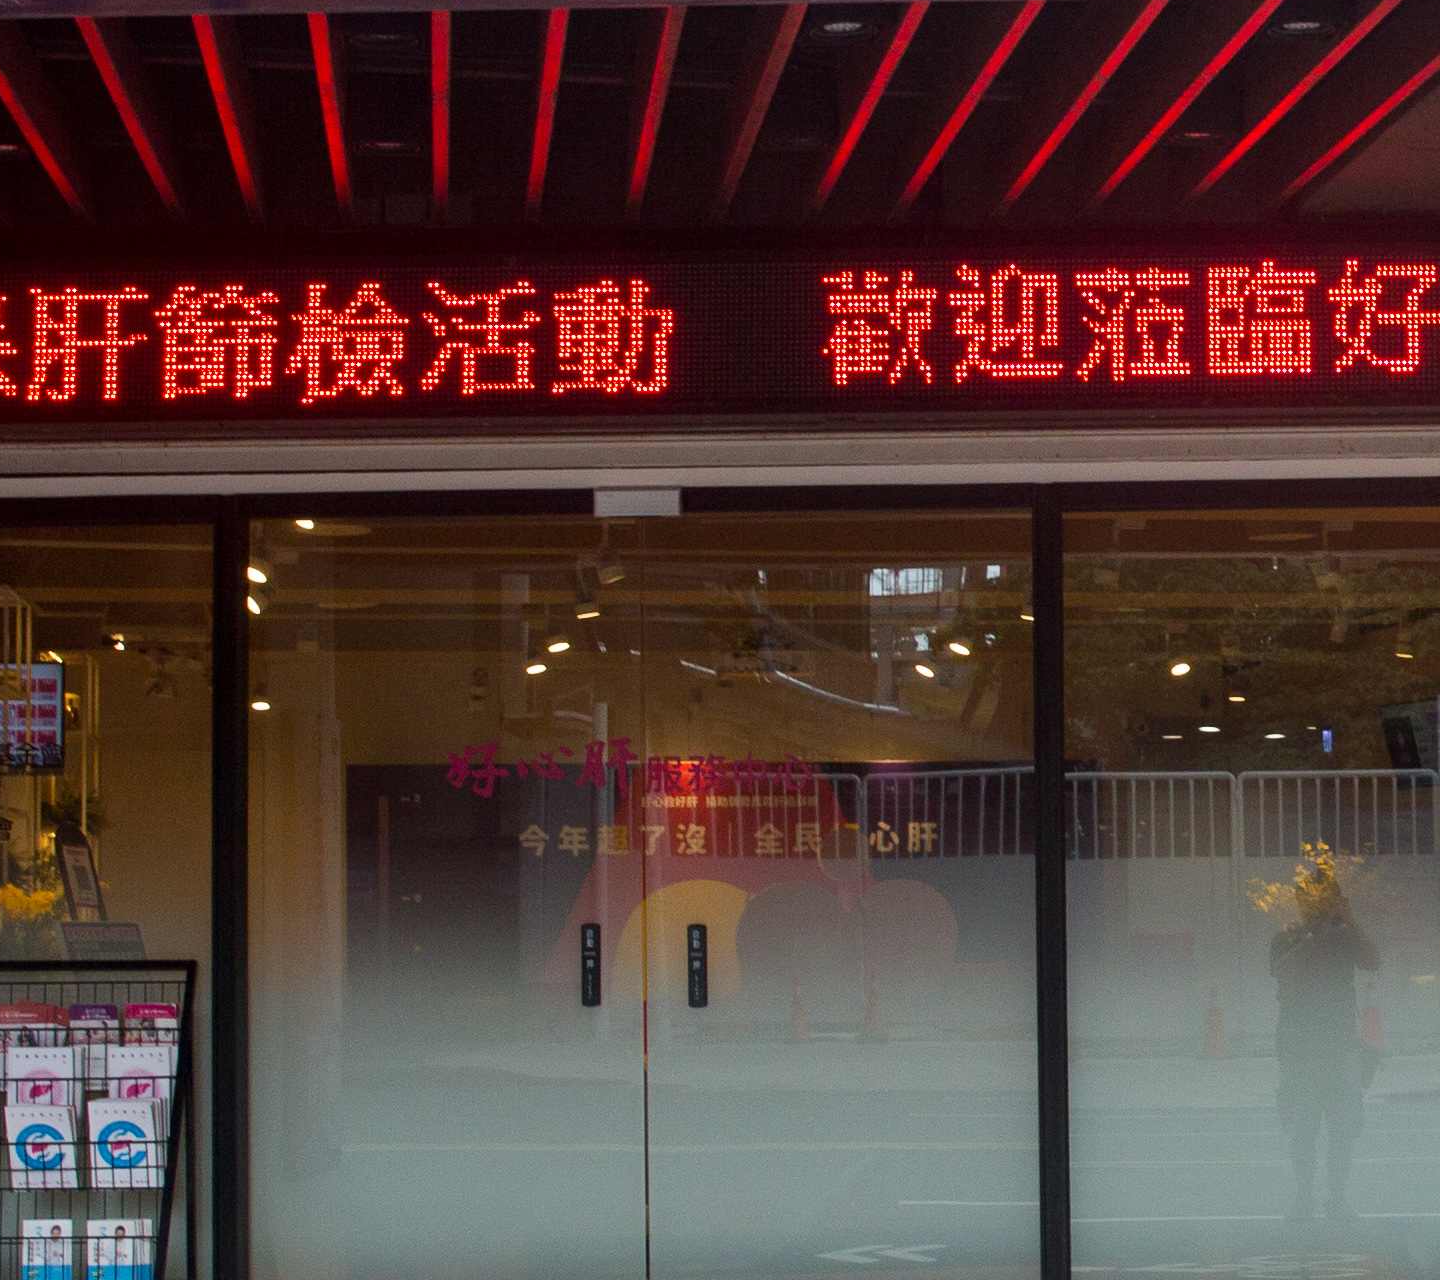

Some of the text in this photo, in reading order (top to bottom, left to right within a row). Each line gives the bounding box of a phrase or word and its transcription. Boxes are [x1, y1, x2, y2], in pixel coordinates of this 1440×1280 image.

[445, 737, 813, 799] 好心肝 服務中心
[753, 821, 938, 856] 全民心肝
